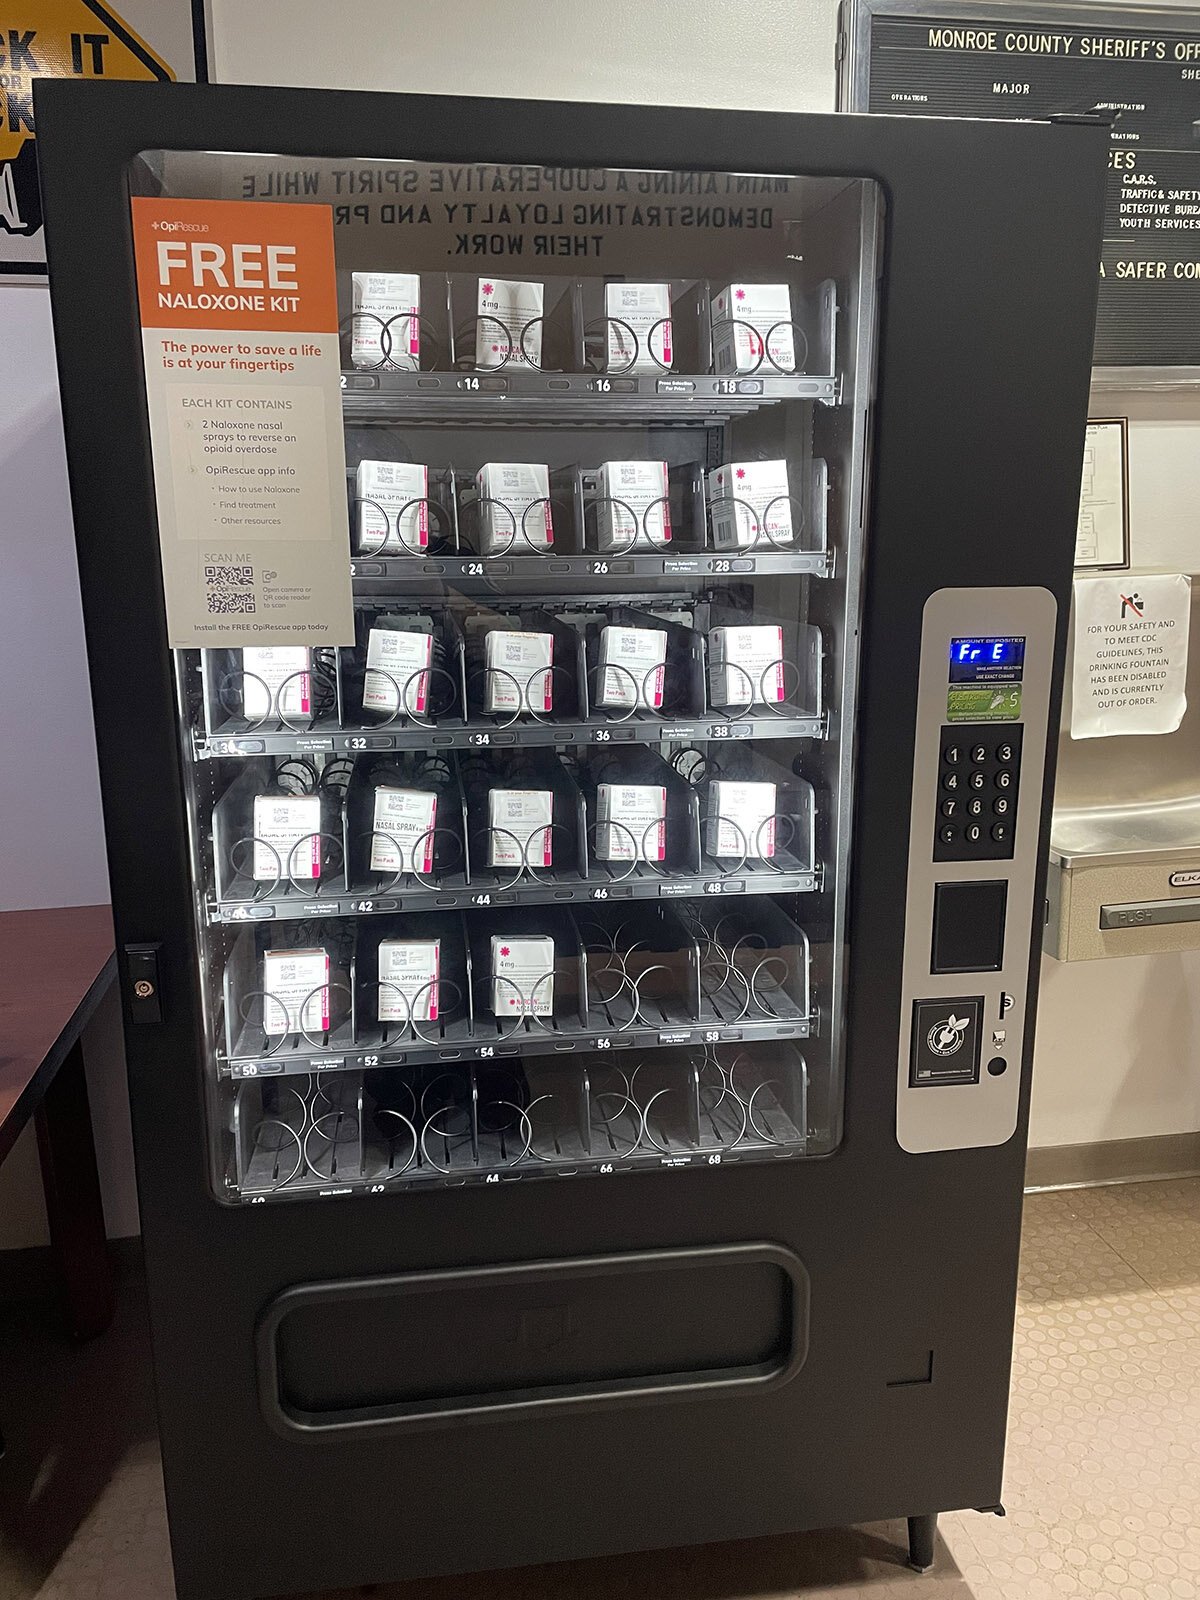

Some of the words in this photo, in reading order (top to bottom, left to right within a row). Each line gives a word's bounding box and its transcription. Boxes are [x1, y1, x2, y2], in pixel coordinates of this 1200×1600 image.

[929, 29, 997, 50] MONROE
[1005, 33, 1073, 54] COUNTY
[1080, 38, 1166, 59] SHERIFF'S
[0, 30, 39, 71] K
[71, 33, 109, 74] IT
[993, 83, 1030, 94] MAJOR
[1108, 151, 1136, 169] ES
[1123, 174, 1157, 185] C.A.R.S.
[1120, 203, 1170, 214] DETECTIVE
[160, 221, 209, 233] OpiRescue
[1120, 218, 1151, 228] YOUTH
[1155, 218, 1200, 229] SERVICES
[156, 241, 298, 290] FREE
[1115, 261, 1167, 278] SAFER
[158, 292, 265, 312] NALOXONE
[270, 296, 300, 313] KIT
[161, 341, 187, 353] The
[190, 344, 234, 356] power
[237, 343, 251, 354] to
[255, 346, 286, 356] save
[289, 347, 298, 356] a
[301, 344, 322, 357] life
[163, 356, 174, 369] is
[178, 358, 193, 369] at
[196, 360, 226, 372] your
[229, 358, 295, 373] fingertips
[464, 378, 480, 390] 14
[596, 380, 611, 392] 16
[722, 379, 737, 393] 18
[182, 398, 213, 409] EACH
[215, 399, 233, 409] KIT
[236, 400, 293, 410] CONTAINS
[202, 420, 209, 429] 2
[211, 420, 255, 430] Naloxone
[257, 420, 283, 430] nasal
[203, 433, 235, 443] sprays
[236, 433, 246, 442] to
[248, 434, 283, 442] reverse
[284, 434, 297, 442] an
[204, 444, 233, 454] opioid
[235, 445, 277, 454] overdose
[205, 465, 255, 476] OpiRescue
[257, 467, 276, 477] app
[278, 465, 296, 476] info
[218, 485, 237, 493] How
[238, 485, 247, 493] to
[264, 485, 301, 494] Naloxone
[219, 501, 236, 509] Find
[238, 501, 276, 509] treatment
[220, 517, 243, 525] Other
[244, 517, 281, 525] resources
[204, 553, 233, 563] SCAN
[235, 553, 252, 563] ME
[468, 563, 484, 575] 24
[593, 562, 608, 574] 26
[715, 559, 730, 572] 28
[1087, 625, 1102, 634] FOR
[1104, 623, 1128, 632] YOUR
[1129, 621, 1156, 631] SAFETY
[1158, 620, 1175, 629] AND
[1105, 637, 1116, 645] TO
[1117, 635, 1140, 644] MEET
[1141, 634, 1157, 643] CDC
[1096, 648, 1145, 659] GUIDELINES,
[1147, 646, 1163, 655] THIS
[1089, 662, 1128, 672] DRINKING
[1129, 658, 1170, 669] FOUNTAIN
[1090, 675, 1106, 684] HAS
[1108, 673, 1128, 683] BEEN
[1130, 671, 1167, 681] DISABLED
[1092, 688, 1110, 697] AND
[1111, 686, 1119, 695] IS
[1120, 684, 1164, 694] CURRENTLY
[1097, 700, 1115, 709] OUT
[1116, 698, 1127, 707] OF
[1128, 696, 1157, 706] ORDER.
[596, 730, 610, 741] 36
[714, 725, 729, 737] 38
[351, 738, 367, 749] 32
[475, 734, 490, 745] 34
[950, 748, 958, 761] 1
[976, 747, 985, 760] 2
[1002, 746, 1011, 760] 3
[948, 775, 957, 788] 4
[975, 774, 984, 788] 5
[1000, 773, 1010, 787] 6
[947, 801, 956, 815] 7
[972, 800, 981, 814] 8
[998, 799, 1008, 813] 9
[375, 821, 395, 830] NASAL
[396, 822, 417, 831] SPRAY
[971, 826, 980, 840] 0
[594, 888, 608, 899] 46
[707, 882, 722, 893] 48
[477, 894, 491, 905] 44
[358, 900, 374, 912] 42
[706, 1031, 720, 1042] 58
[597, 1039, 611, 1049] 56
[480, 1047, 494, 1057] 54
[364, 1055, 379, 1067] 52
[242, 1064, 258, 1076] 50
[708, 1155, 721, 1165] 68
[600, 1164, 613, 1174] 66
